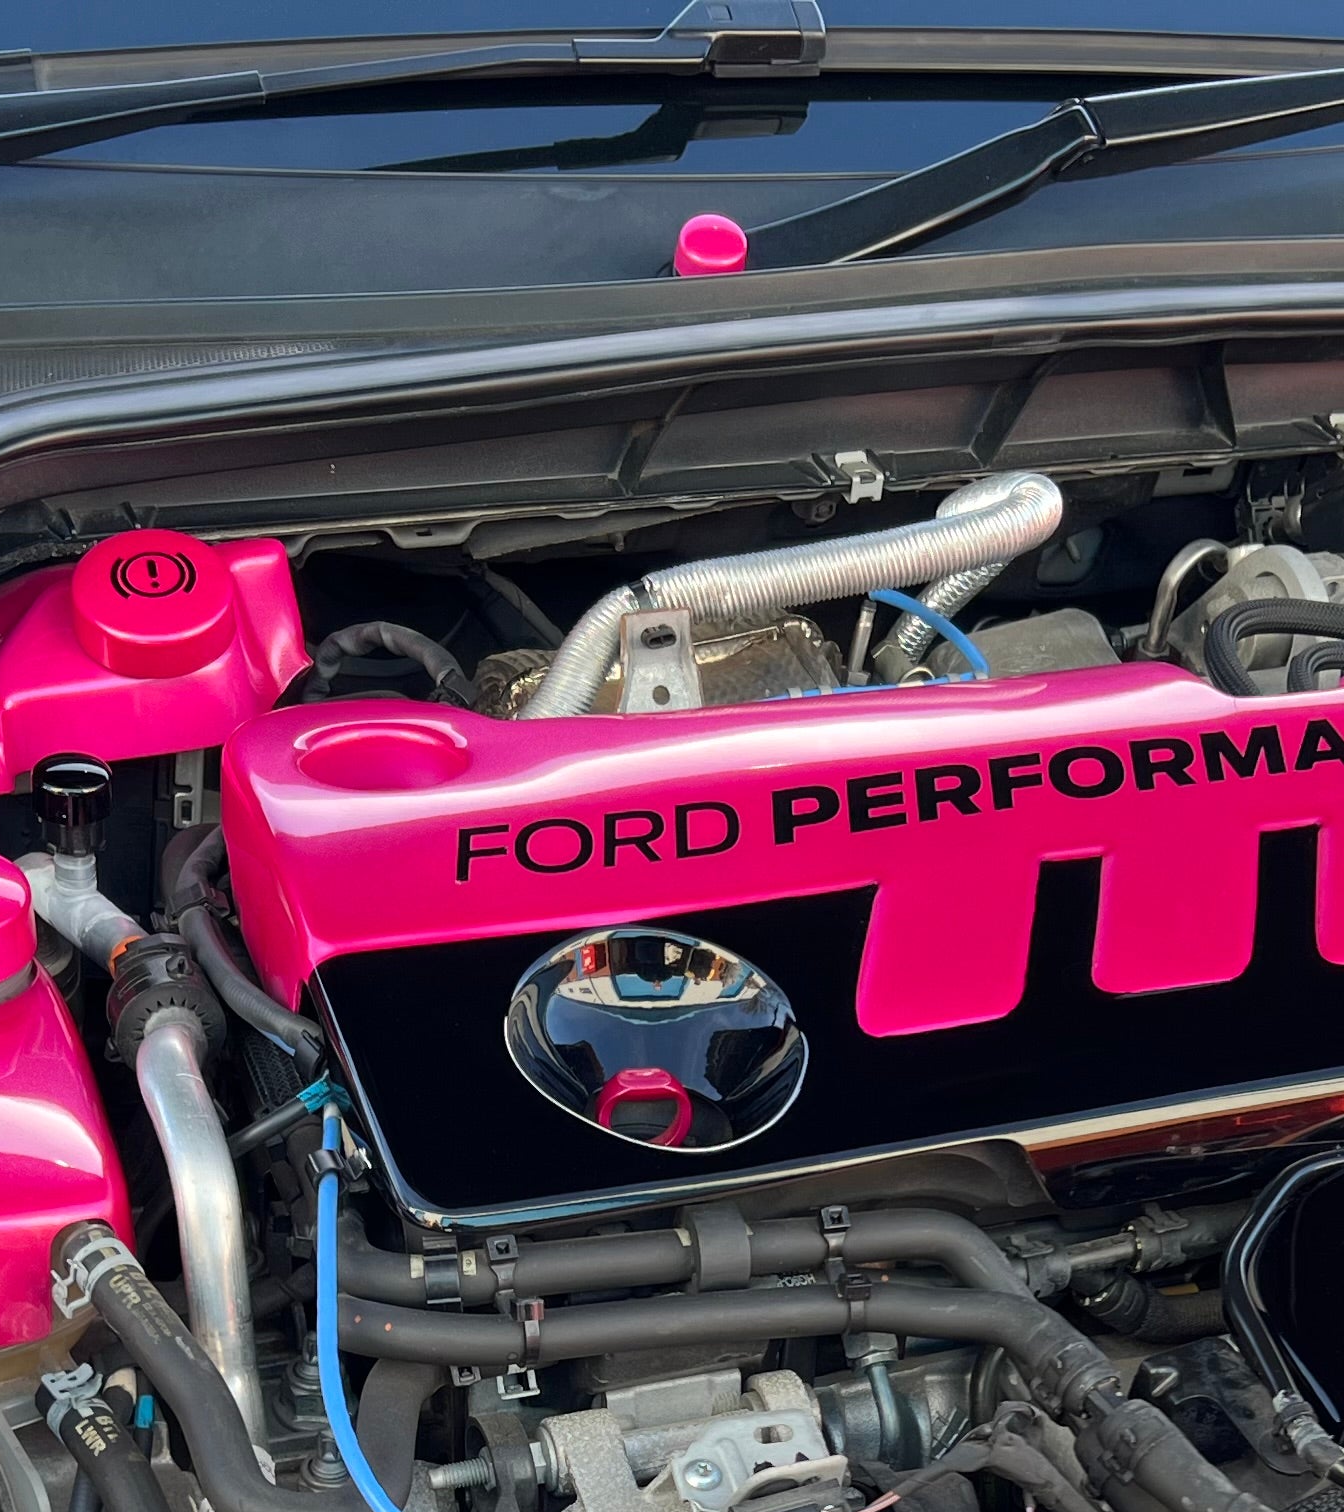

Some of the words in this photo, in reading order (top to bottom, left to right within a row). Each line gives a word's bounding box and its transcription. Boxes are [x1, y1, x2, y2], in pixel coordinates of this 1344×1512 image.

[455, 801, 740, 885] FORD
[109, 1274, 141, 1310] UPR
[75, 1419, 106, 1457] LWR
